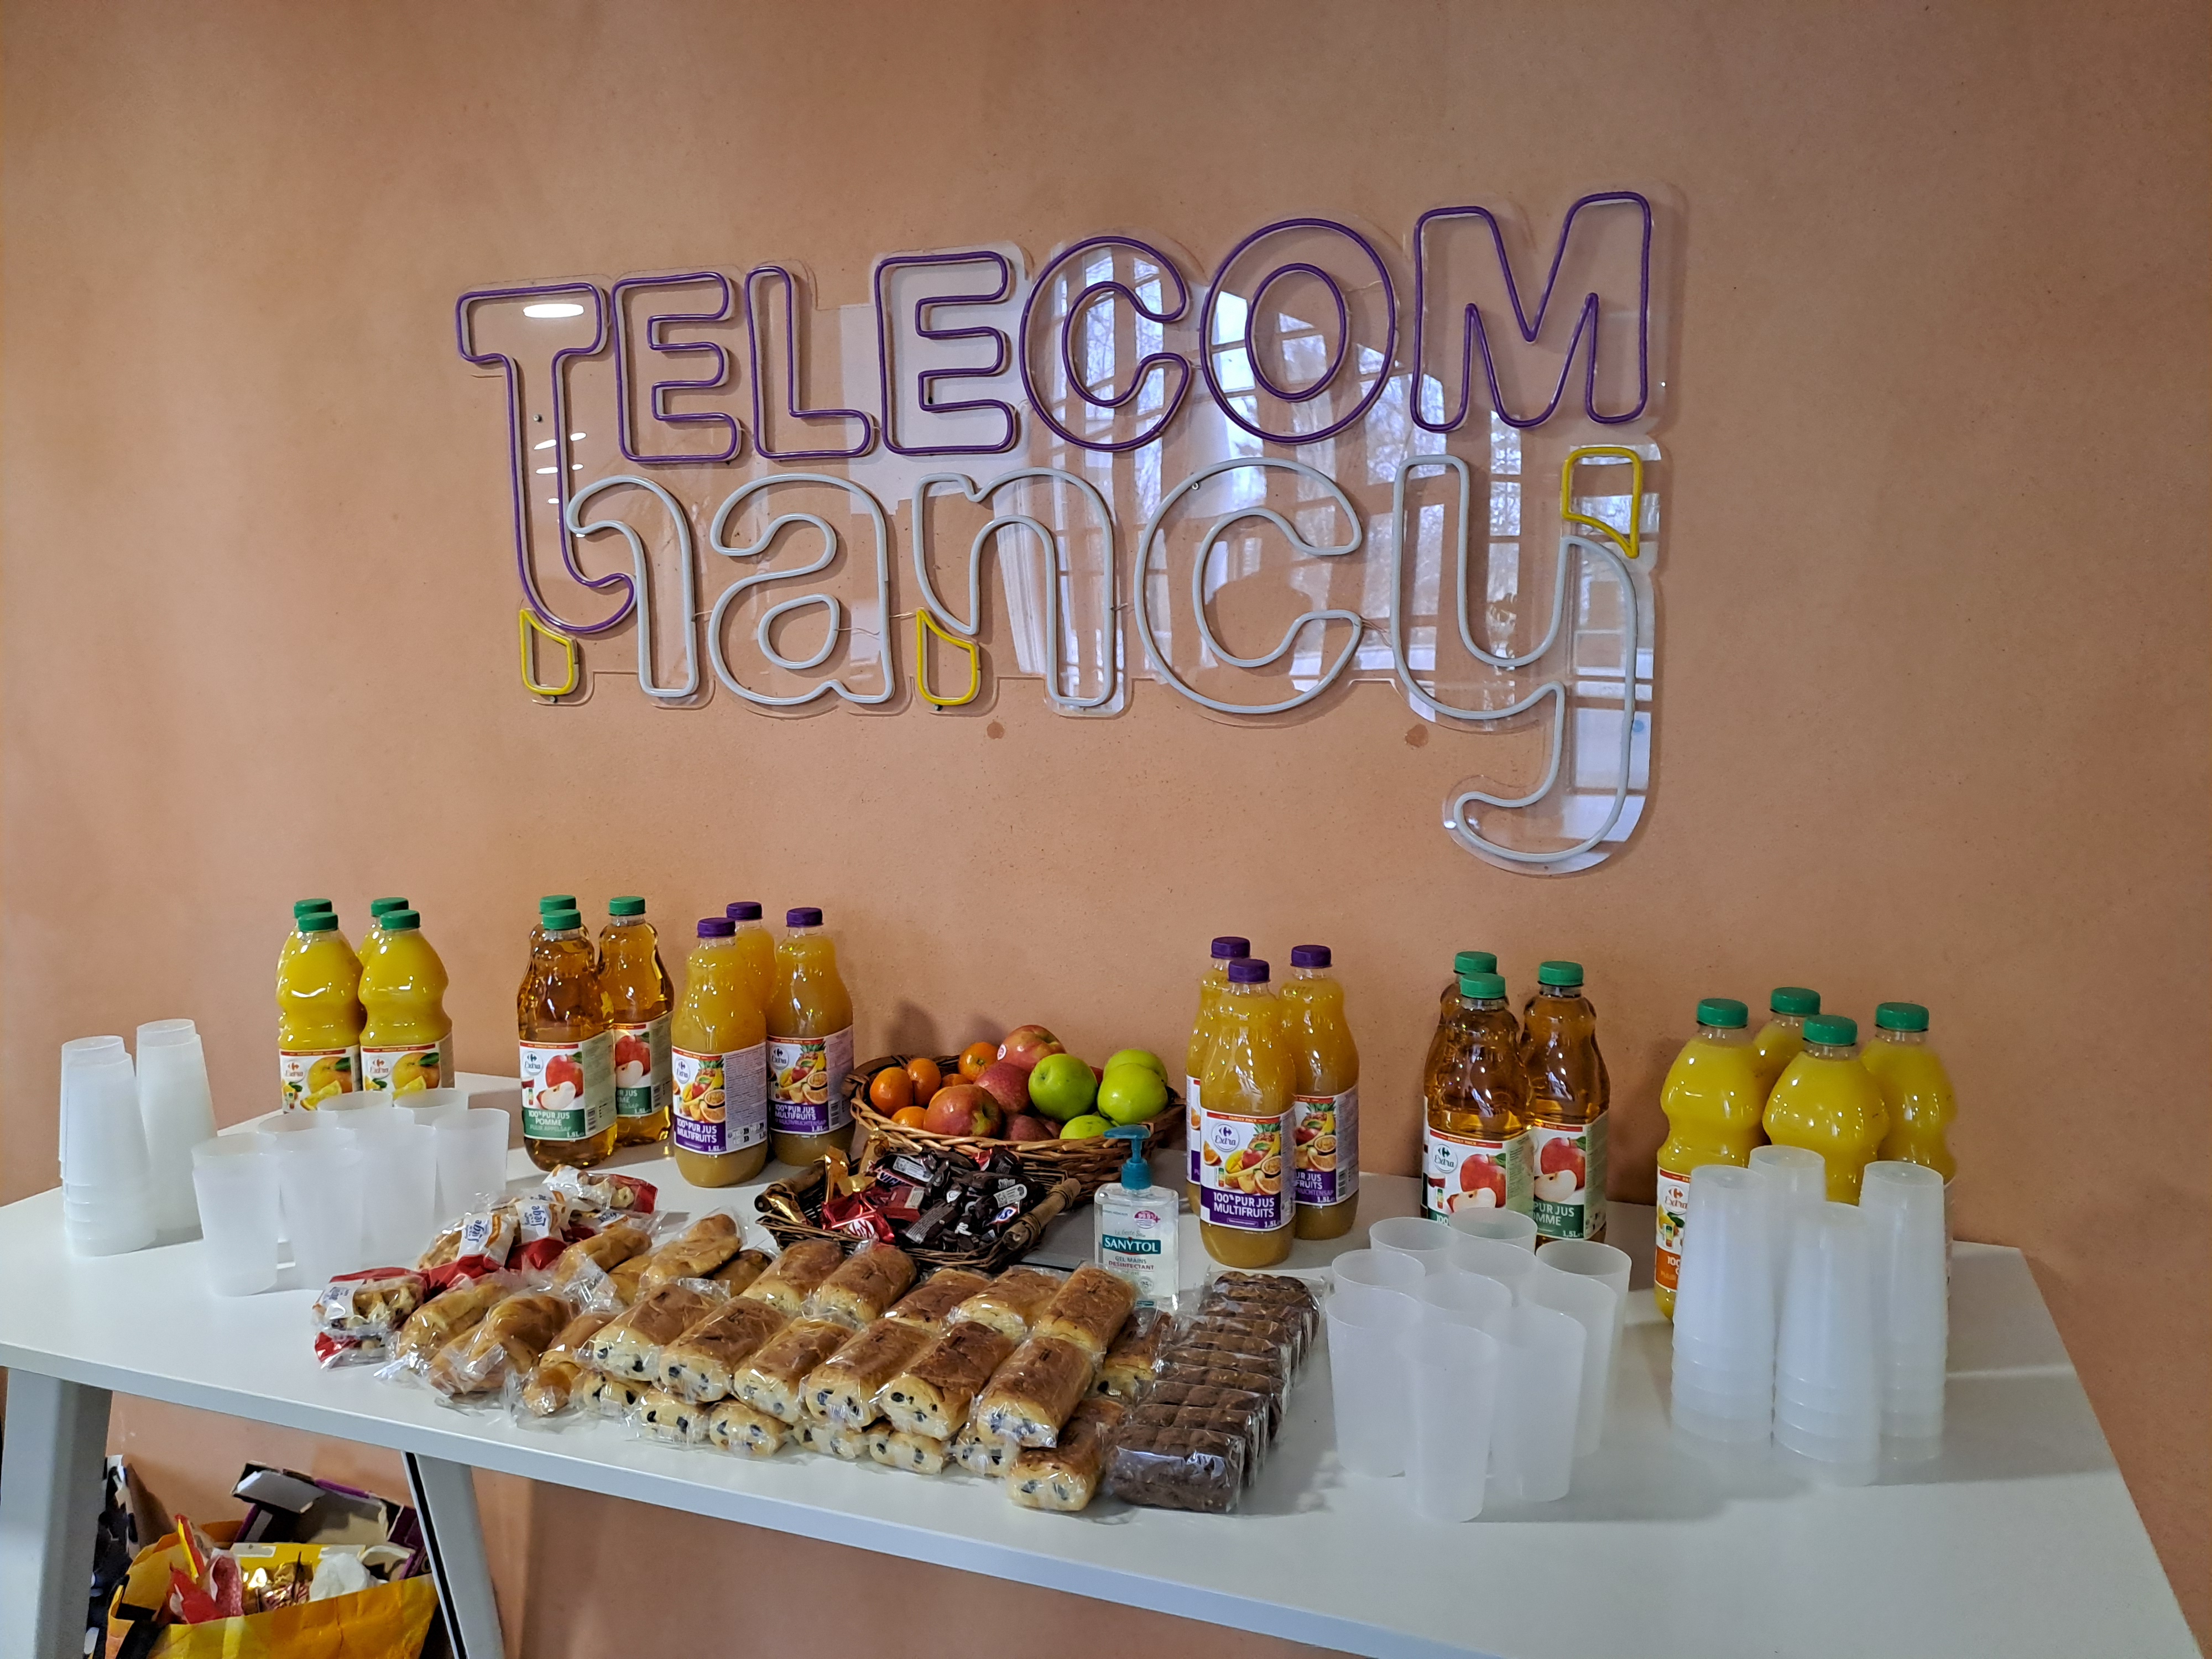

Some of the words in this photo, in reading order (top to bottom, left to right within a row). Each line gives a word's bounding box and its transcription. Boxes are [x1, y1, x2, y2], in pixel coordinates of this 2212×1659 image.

[455, 192, 1652, 634] TELECOM
[788, 1105, 802, 1113] PUR
[775, 1112, 816, 1120] MULTIFRUITS
[535, 1118, 562, 1126] POMME
[688, 1123, 700, 1132] PUR
[702, 1125, 717, 1134] JUS
[677, 1127, 717, 1144] MULTIFRUITS
[1215, 1135, 1236, 1146] Extra
[1434, 1154, 1454, 1168] Extra
[1296, 1171, 1306, 1181] UR
[1307, 1173, 1322, 1182] JUS
[1295, 1180, 1323, 1190] FRUITS
[1213, 1192, 1234, 1203] 100%
[1235, 1196, 1255, 1207] PUR
[1256, 1197, 1275, 1208] JUS
[1214, 1202, 1274, 1218] MULTIFRUITS
[1554, 1206, 1574, 1217] JUS
[1436, 1214, 1448, 1224] 100
[1104, 1237, 1159, 1253] SANYTOL
[1667, 1255, 1680, 1267] 100
